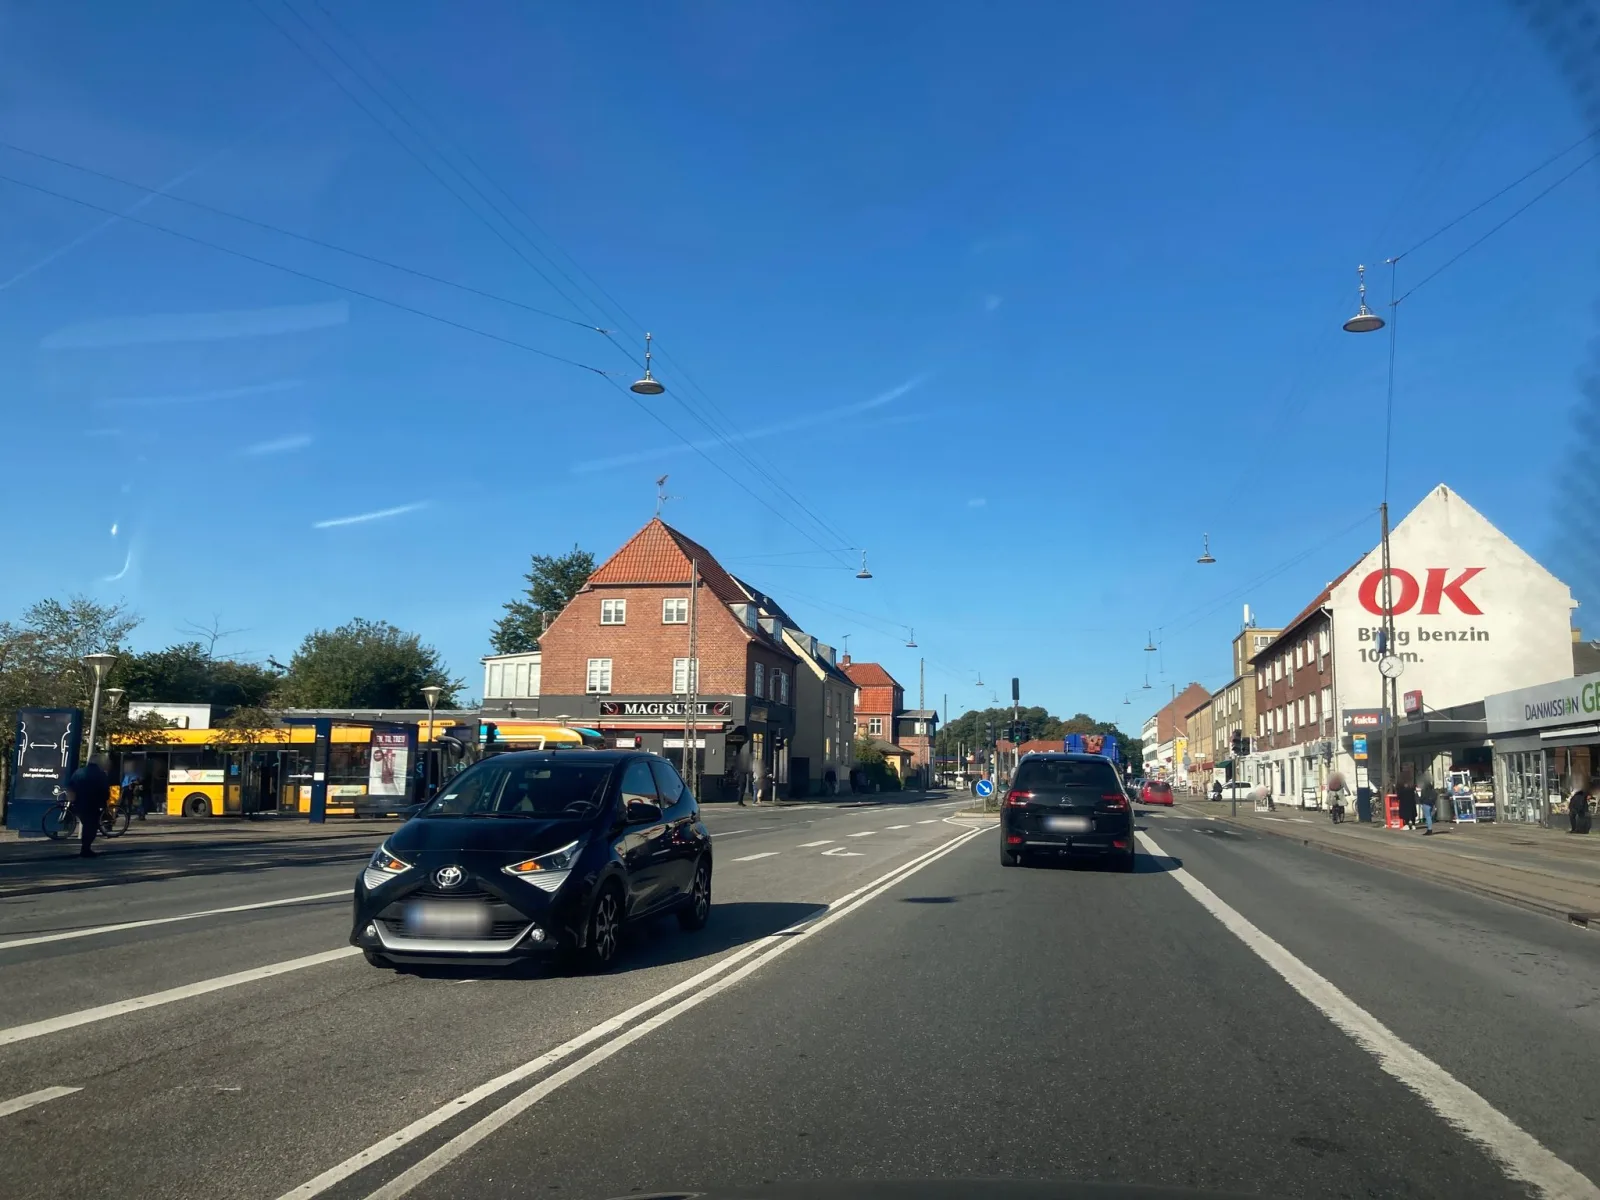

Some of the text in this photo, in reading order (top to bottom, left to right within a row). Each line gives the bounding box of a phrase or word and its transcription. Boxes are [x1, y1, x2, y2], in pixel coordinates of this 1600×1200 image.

[1358, 567, 1486, 616] OK
[1417, 627, 1489, 641] benzin
[624, 703, 664, 715] MAGI
[1525, 696, 1579, 720] DANMISSION
[1354, 715, 1377, 725] fakta
